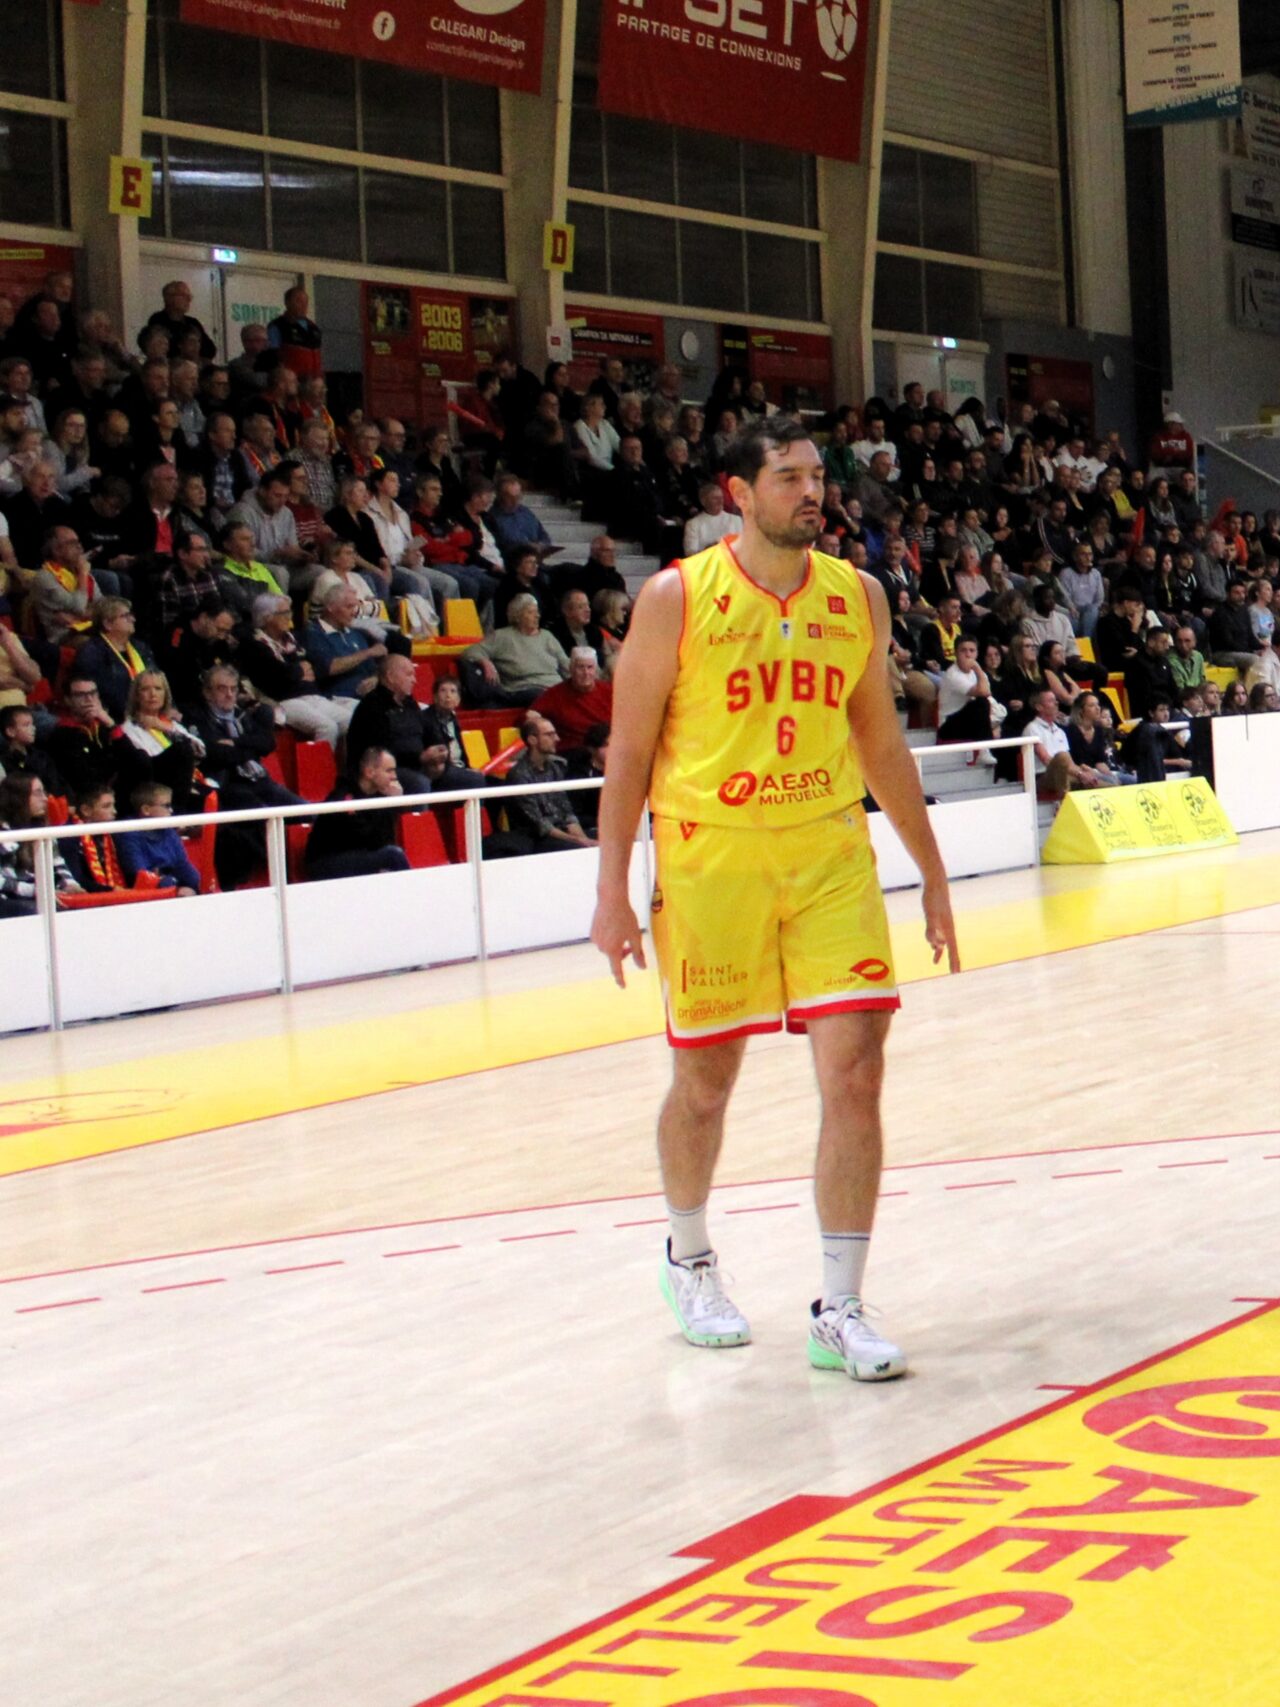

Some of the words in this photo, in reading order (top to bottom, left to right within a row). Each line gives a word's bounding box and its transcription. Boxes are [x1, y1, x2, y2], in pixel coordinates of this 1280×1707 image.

[430, 16, 488, 44] CALEGARI
[489, 31, 526, 52] Design
[617, 13, 691, 44] PARTAGE
[695, 32, 715, 50] DE
[719, 38, 802, 71] CONNEXIONS
[120, 165, 143, 209] E
[551, 230, 567, 264] D
[420, 303, 463, 331] 2003
[427, 329, 464, 353] 2006
[726, 659, 845, 714] SVBD
[776, 715, 797, 758] 6
[759, 787, 835, 806] MUTUELLE
[690, 964, 733, 977] SAINT
[690, 972, 748, 987] VALLIER
